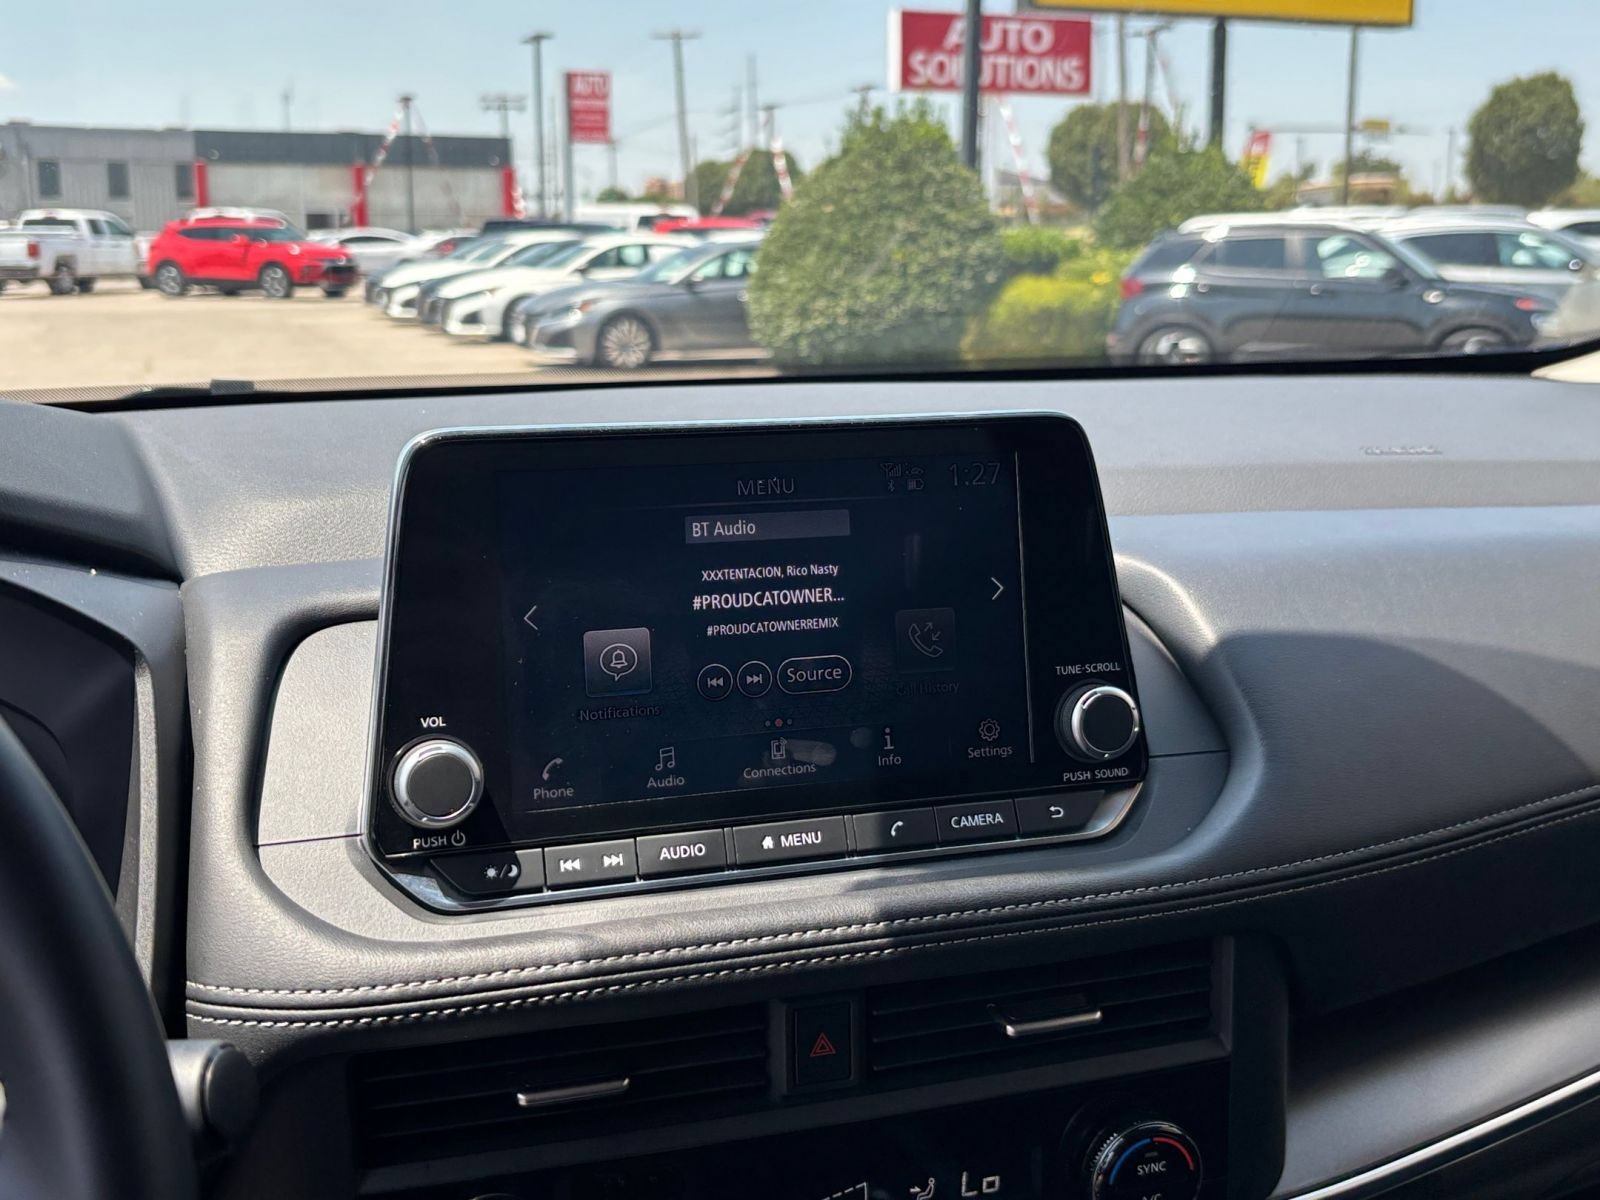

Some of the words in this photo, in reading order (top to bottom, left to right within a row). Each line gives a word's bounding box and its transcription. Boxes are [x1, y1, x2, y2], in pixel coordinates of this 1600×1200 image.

[949, 463, 1001, 486] 1:27
[737, 477, 795, 496] MENU
[691, 522, 709, 538] BT
[713, 520, 757, 536] Audio
[701, 566, 784, 582] XXXTENTACION,
[786, 565, 808, 577] Rico
[810, 563, 839, 578] Nasty
[692, 587, 845, 611] #PROUDCATOWNER...
[706, 616, 839, 637] #PROUDCATOWNERREMIX
[786, 666, 842, 683] Source
[579, 704, 661, 722] Notifications
[420, 716, 447, 728] VOL
[878, 754, 902, 767] Info
[967, 744, 1013, 760] Settings
[743, 761, 816, 779] Connections
[1063, 770, 1090, 782] PUSH
[1094, 767, 1129, 780] SOUND
[647, 774, 685, 789] Audio
[533, 785, 575, 800] Phone
[950, 812, 1004, 829] CAMERA
[413, 835, 448, 849] PUSH
[780, 831, 822, 848] MENU
[659, 843, 706, 861] AUDIO
[1136, 1160, 1167, 1176] SYNC
